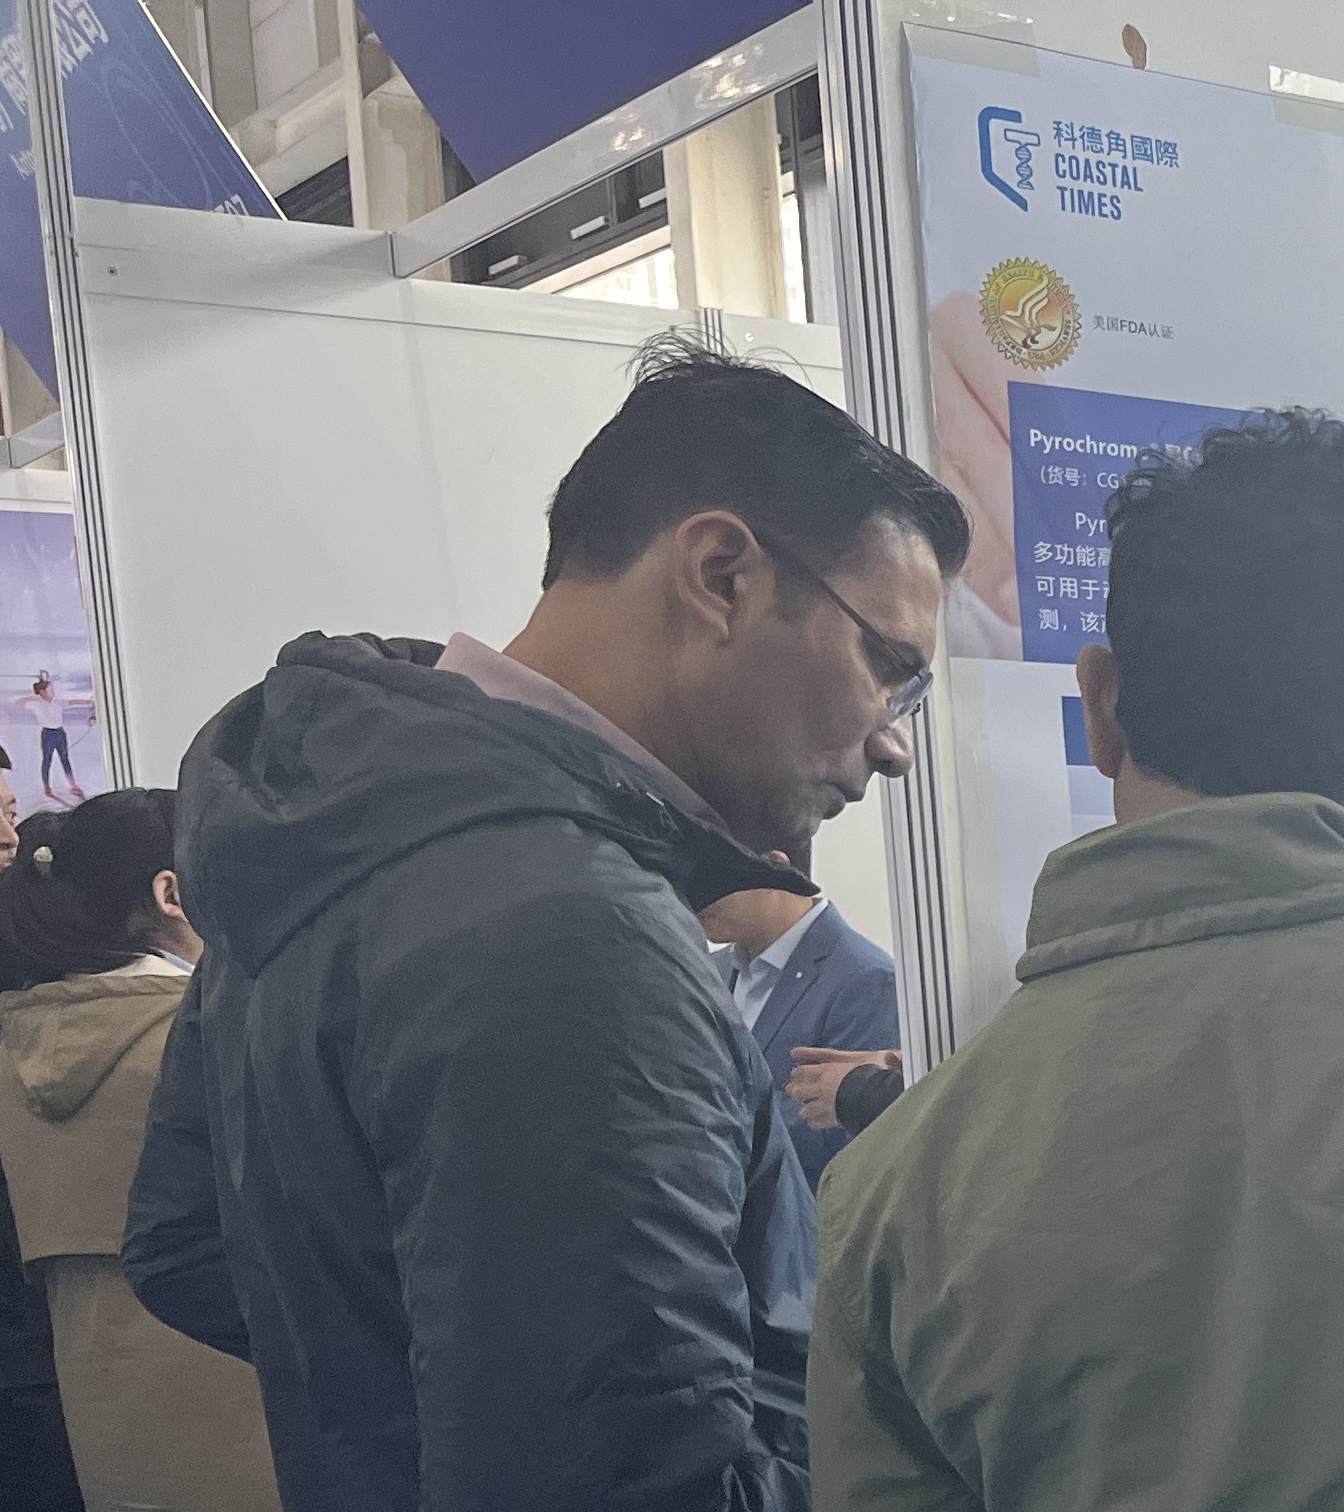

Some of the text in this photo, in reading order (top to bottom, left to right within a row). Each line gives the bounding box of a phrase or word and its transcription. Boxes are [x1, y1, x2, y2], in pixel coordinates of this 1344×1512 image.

[1052, 120, 1180, 168] 科德角國際
[1054, 153, 1143, 192] COASTAL
[1056, 186, 1122, 220] TIMES
[1092, 315, 1174, 339] 美国FDA认证
[1029, 429, 1138, 459] Pyrochrom
[1035, 575, 1111, 600] 可用于
